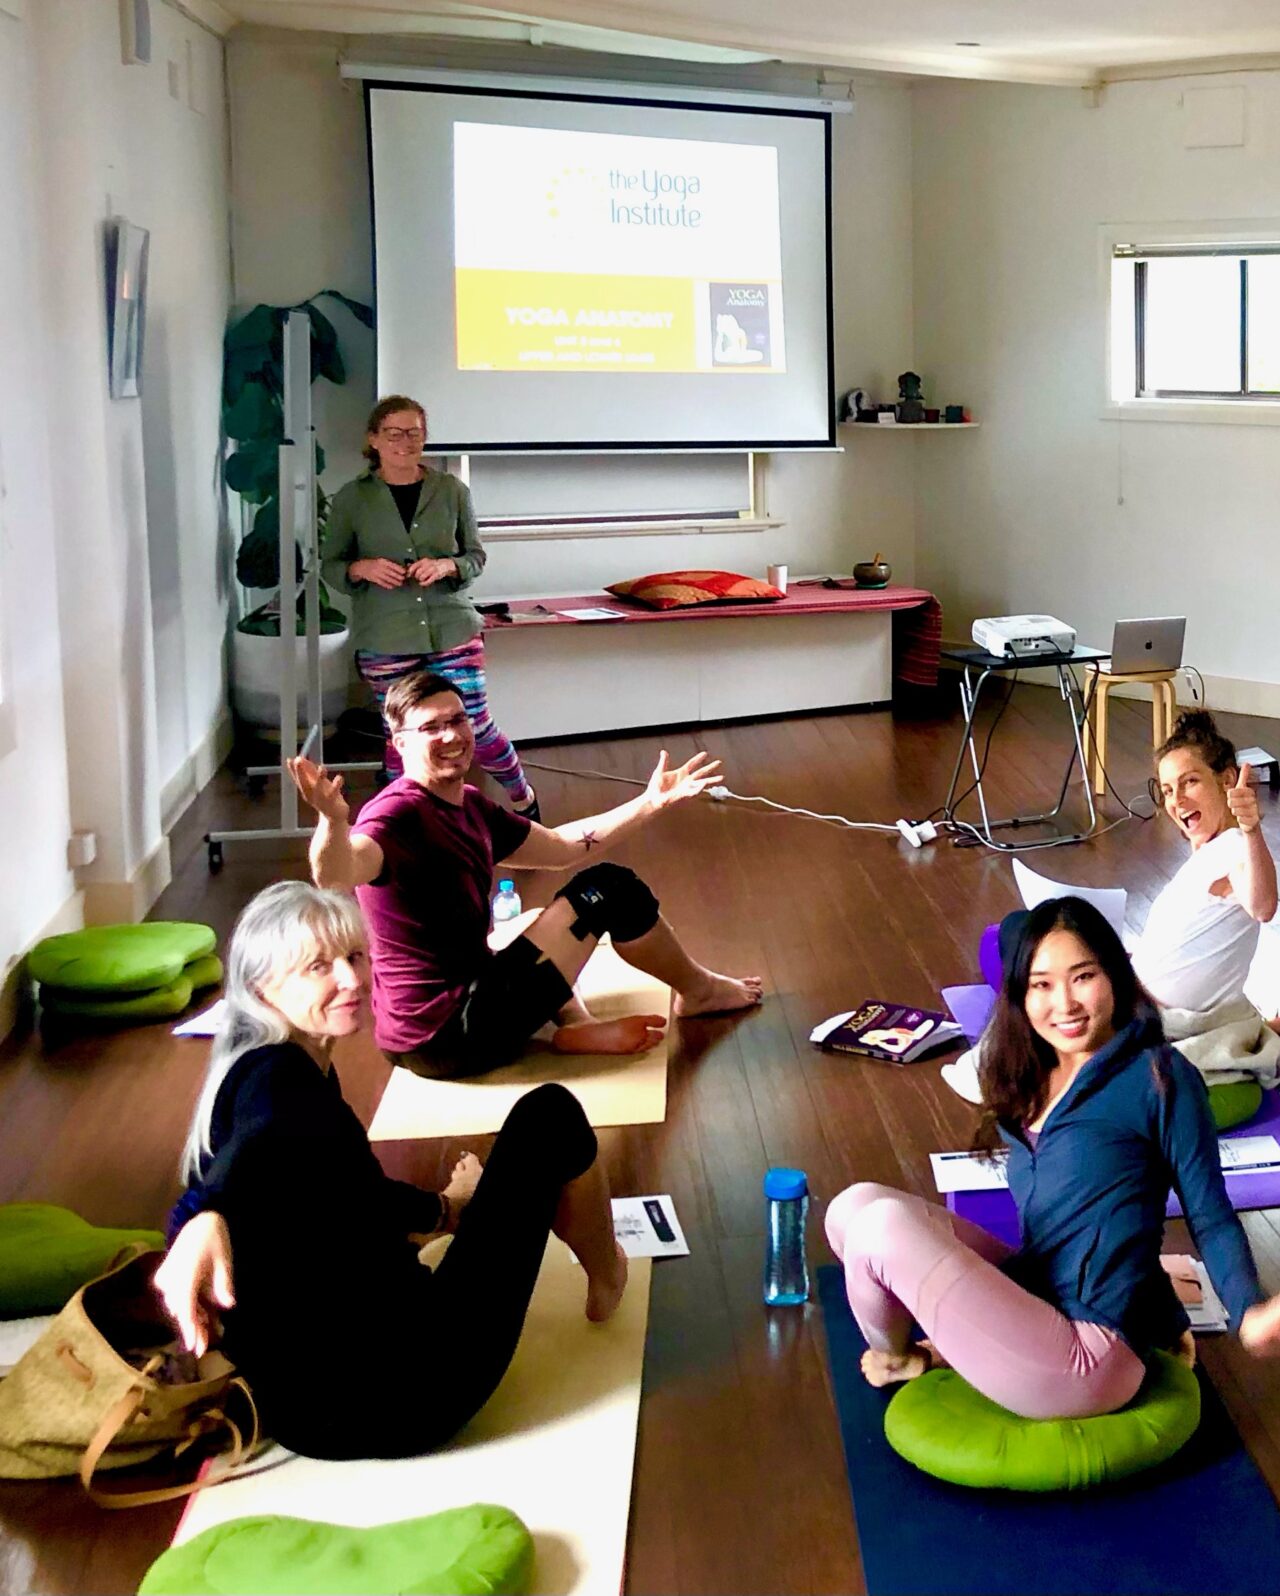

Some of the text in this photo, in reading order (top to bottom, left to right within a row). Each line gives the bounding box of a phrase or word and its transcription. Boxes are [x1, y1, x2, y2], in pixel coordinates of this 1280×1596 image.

[609, 168, 701, 201] the Yoga
[611, 198, 701, 228] Institute
[728, 288, 765, 300] YOGA
[505, 307, 569, 326] YOGA
[575, 309, 674, 329] ANATOMY
